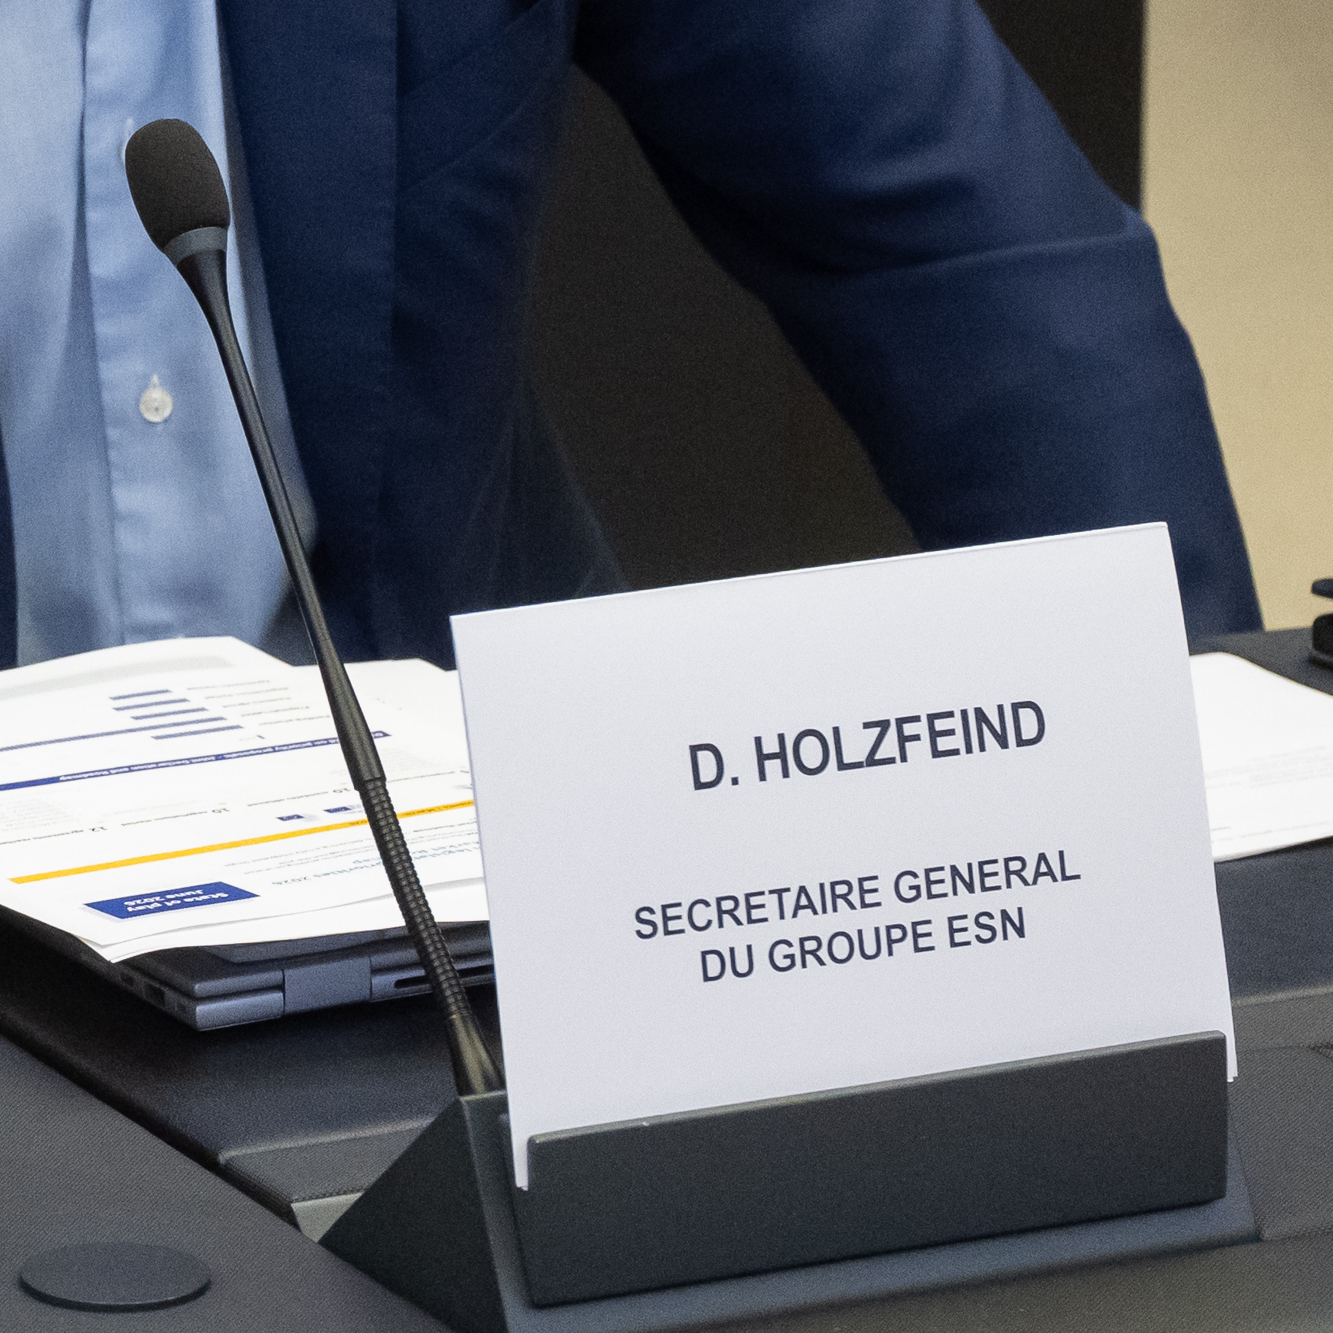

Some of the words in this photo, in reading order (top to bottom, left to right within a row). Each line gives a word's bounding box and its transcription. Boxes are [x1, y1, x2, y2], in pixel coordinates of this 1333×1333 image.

[689, 742, 740, 791] D.
[754, 700, 1047, 783] HOLZFEIND
[162, 889, 207, 898] June
[181, 892, 230, 902] State
[634, 874, 883, 940] SECRETAIRE
[893, 849, 1081, 905] GENERAL
[121, 896, 165, 905] 2026
[122, 902, 165, 912] play
[700, 944, 756, 983] DU
[767, 920, 935, 974] GROUPE
[948, 905, 1027, 949] ESN
